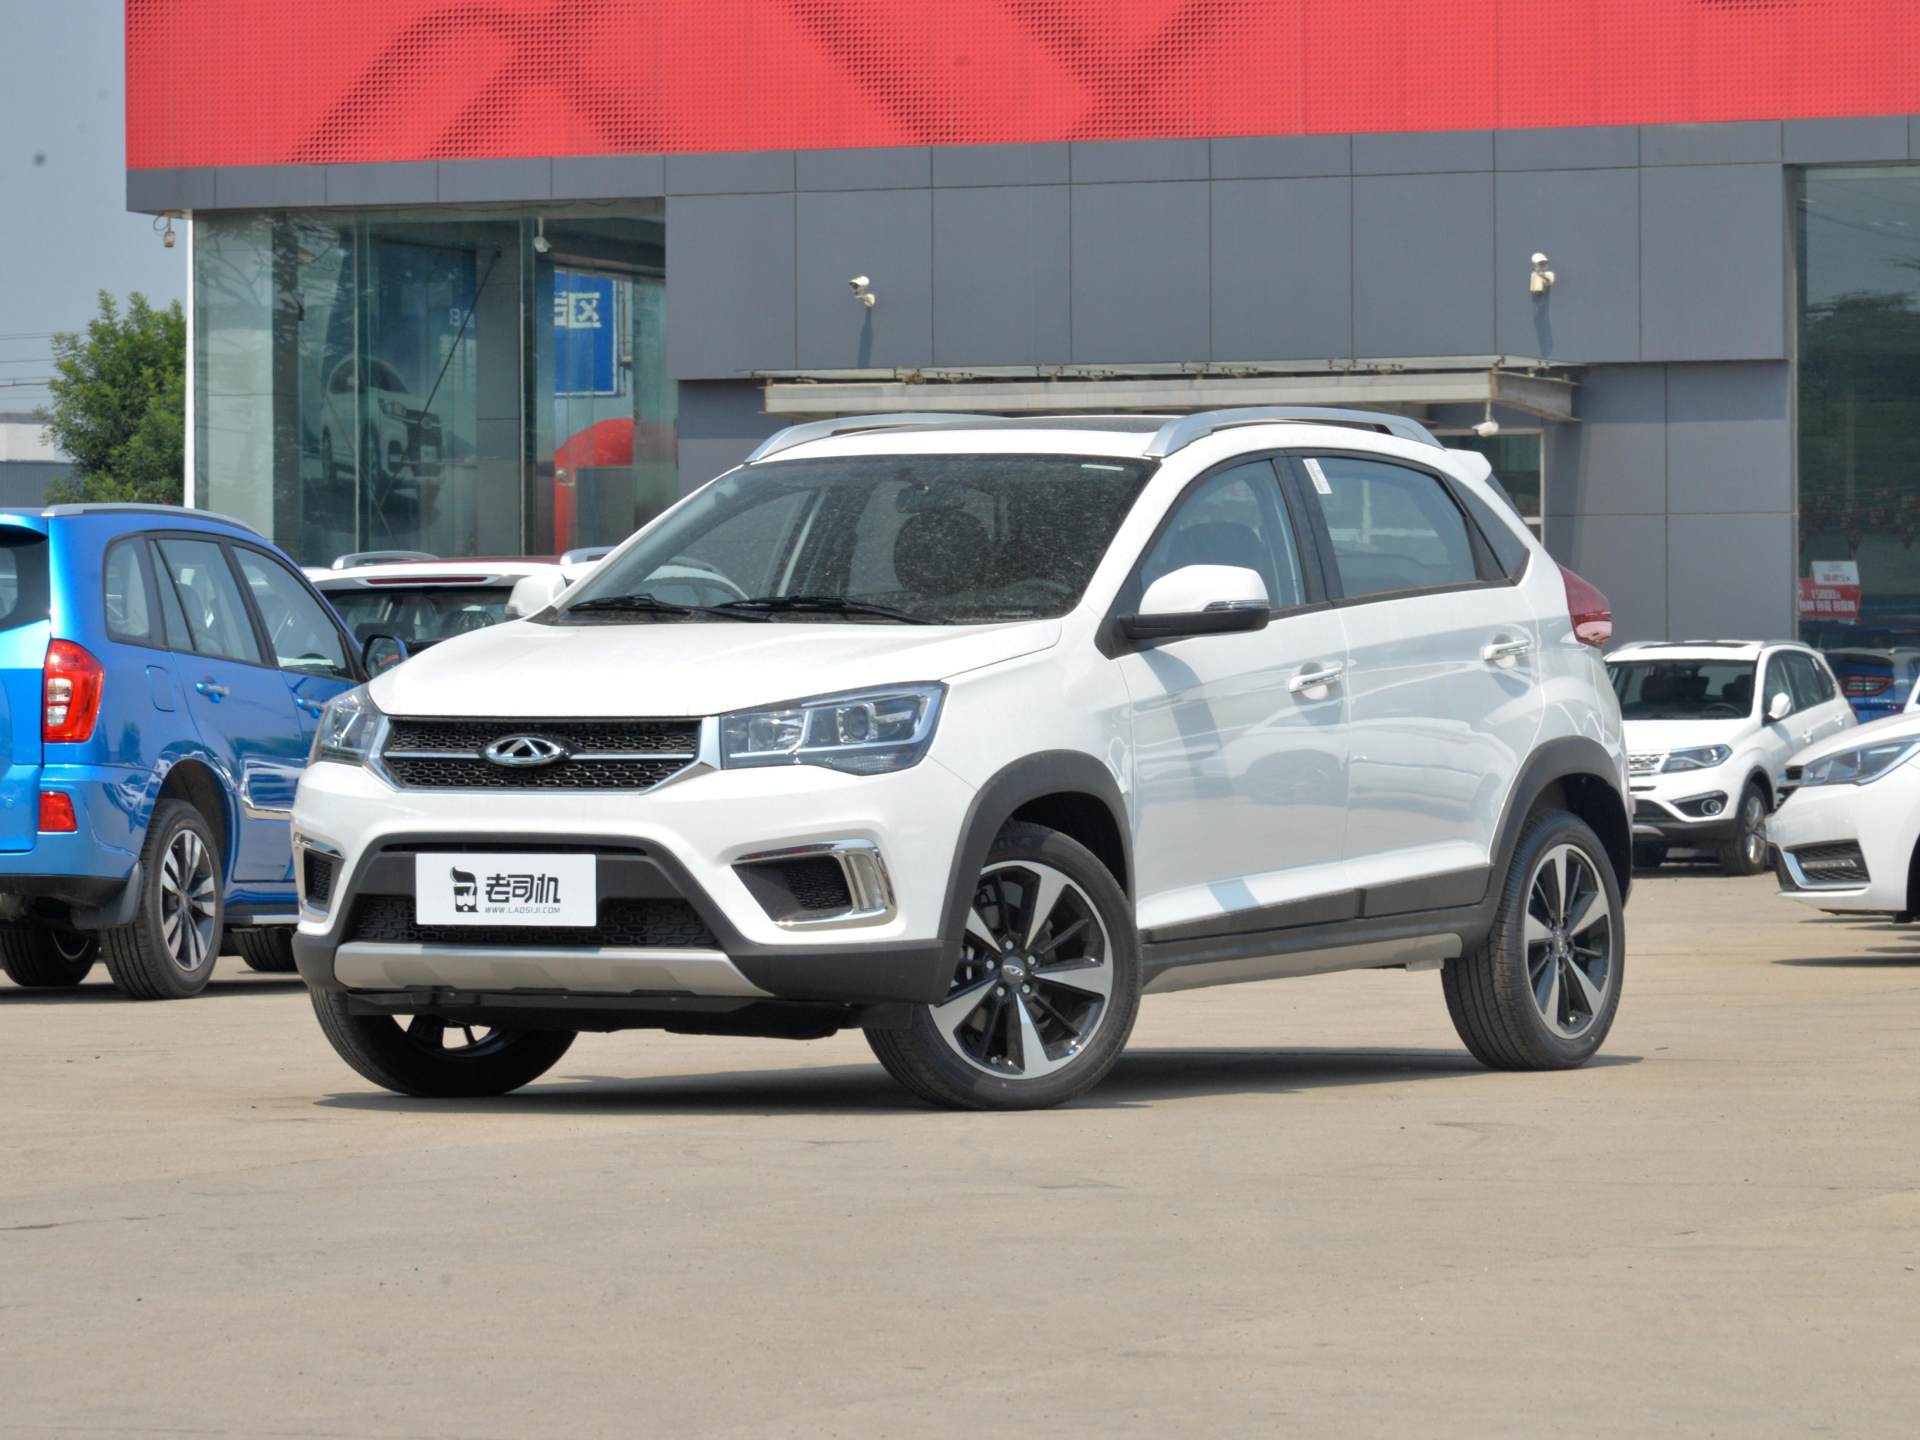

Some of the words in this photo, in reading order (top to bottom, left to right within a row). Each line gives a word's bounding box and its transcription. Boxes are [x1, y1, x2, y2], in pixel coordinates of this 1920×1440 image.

[485, 873, 561, 904] 老司机
[485, 906, 561, 914] WWW.LAOSIJI.COM
